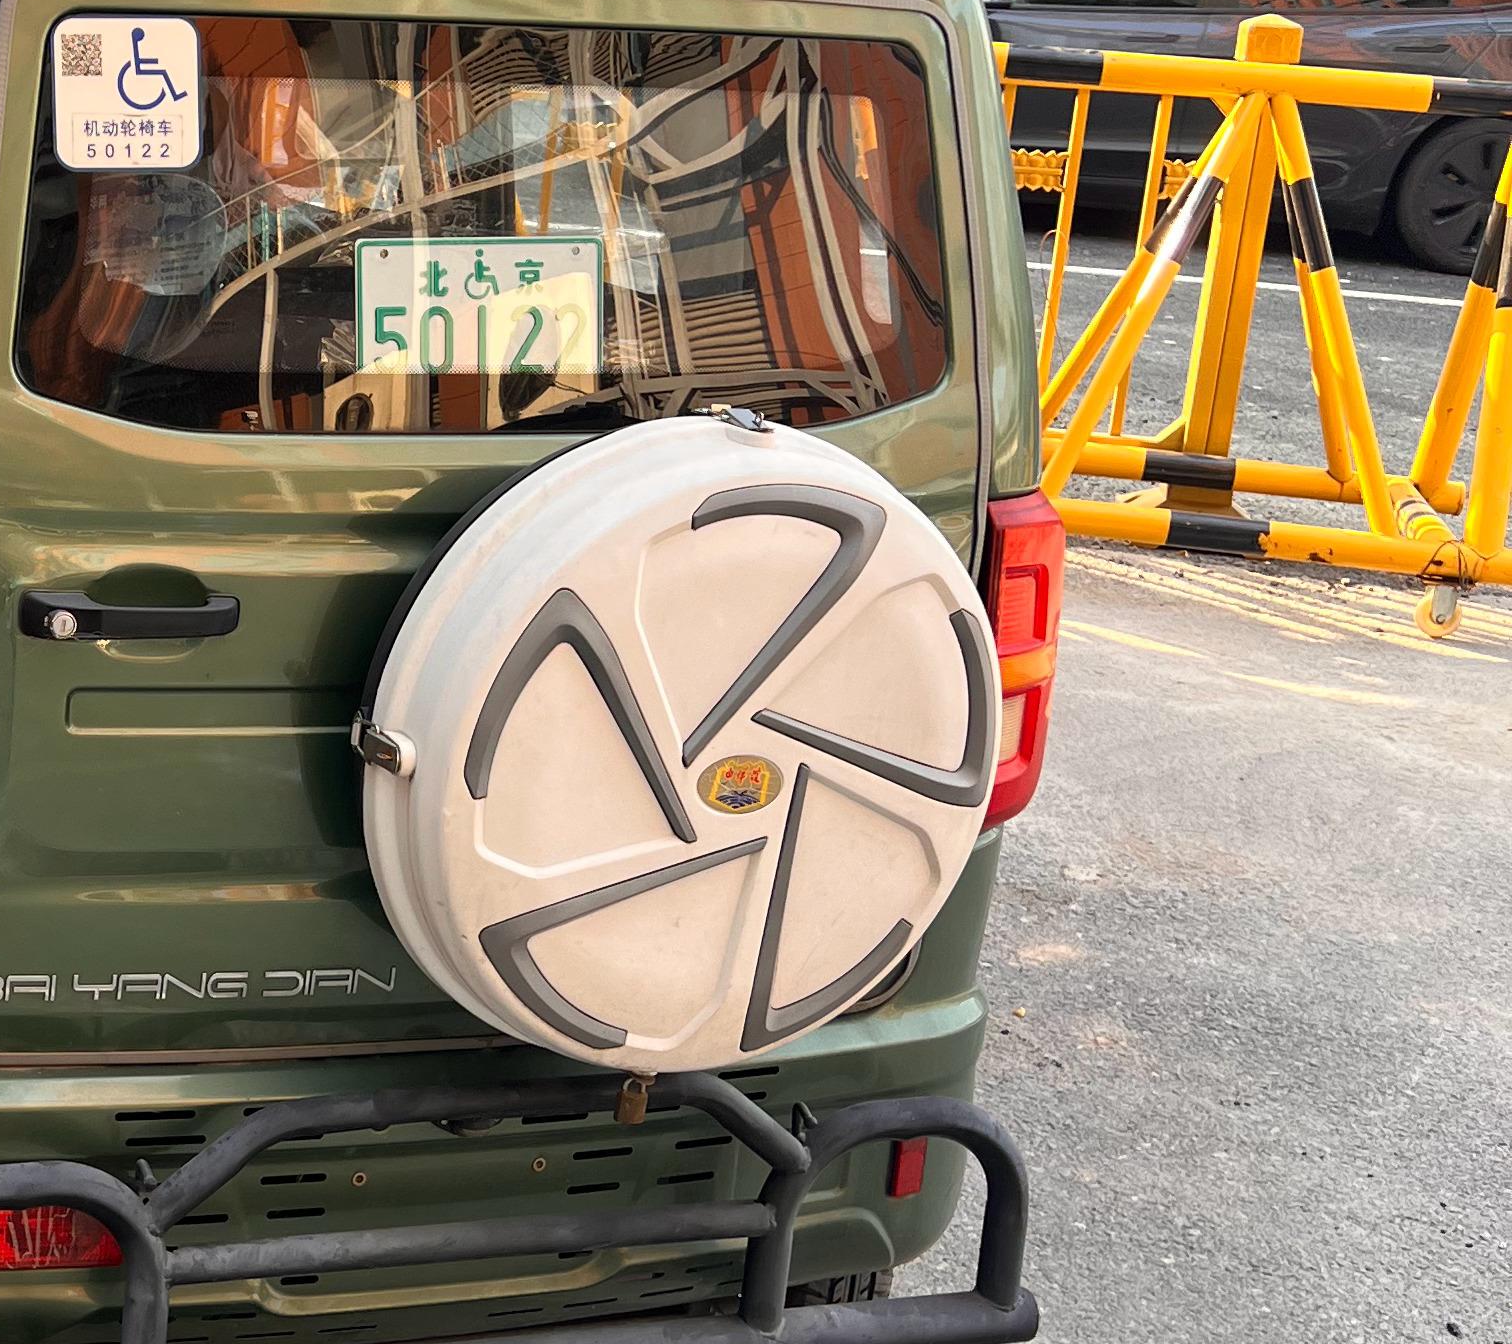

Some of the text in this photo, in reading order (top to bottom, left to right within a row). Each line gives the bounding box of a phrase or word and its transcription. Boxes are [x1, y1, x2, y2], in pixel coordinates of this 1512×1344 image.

[83, 119, 174, 137] 机动轮椅车
[87, 143, 170, 158] 50122
[374, 303, 587, 374] 50122
[73, 970, 250, 1001] YANG
[262, 966, 397, 998] DIAN
